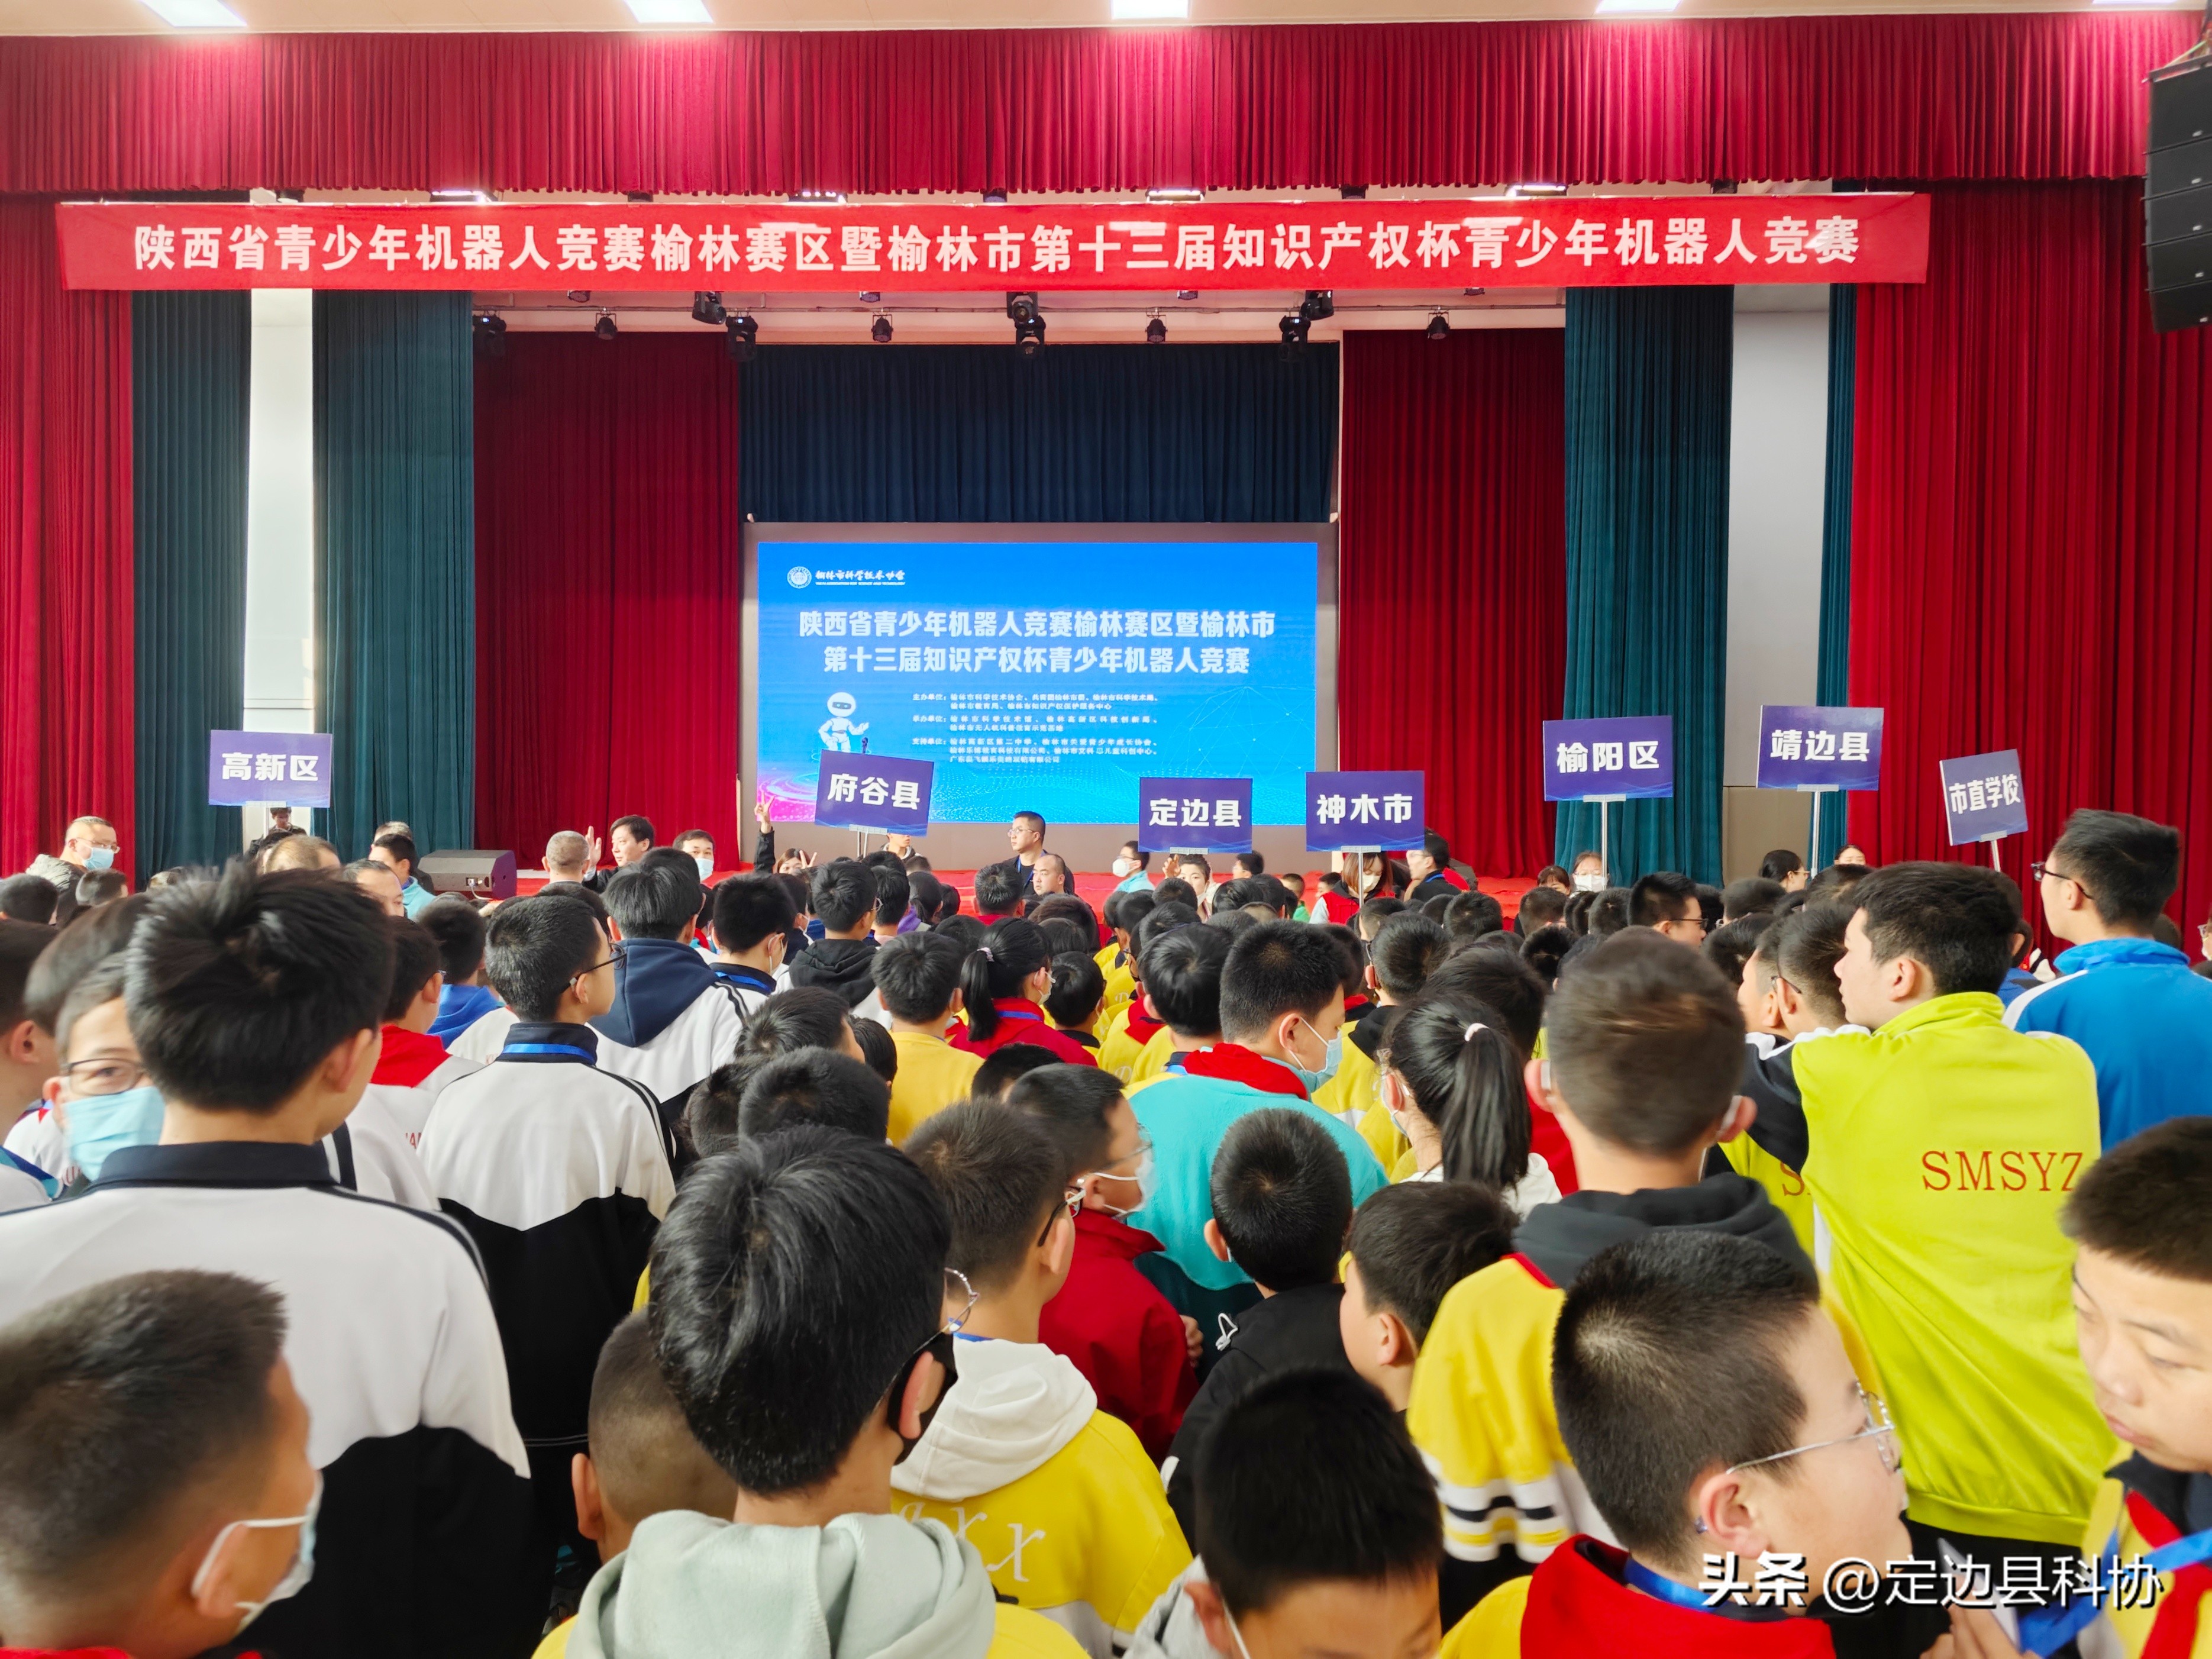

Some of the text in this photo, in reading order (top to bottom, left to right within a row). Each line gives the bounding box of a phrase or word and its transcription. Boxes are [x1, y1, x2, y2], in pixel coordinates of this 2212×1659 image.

[134, 215, 1859, 273] 陕西省青少年机器人竞赛榆林赛区暨榆林市第十三届知识产权杯青少年机器人竞赛
[799, 610, 1275, 638] 陕西省青少年机器人竞赛榆林赛区暨榆林市
[824, 645, 1249, 674] 第十三届知识产权杯青少年机器人竞赛
[1557, 740, 1660, 773] 榆阳区
[1770, 729, 1870, 763] 靖边县
[222, 752, 319, 782] 高新区
[827, 773, 920, 810] 府谷县
[1949, 773, 2021, 816] 市直学校
[1149, 798, 1242, 827] 定边县
[1316, 793, 1413, 824] 神木市
[1922, 1150, 2083, 1192] SMSYZ
